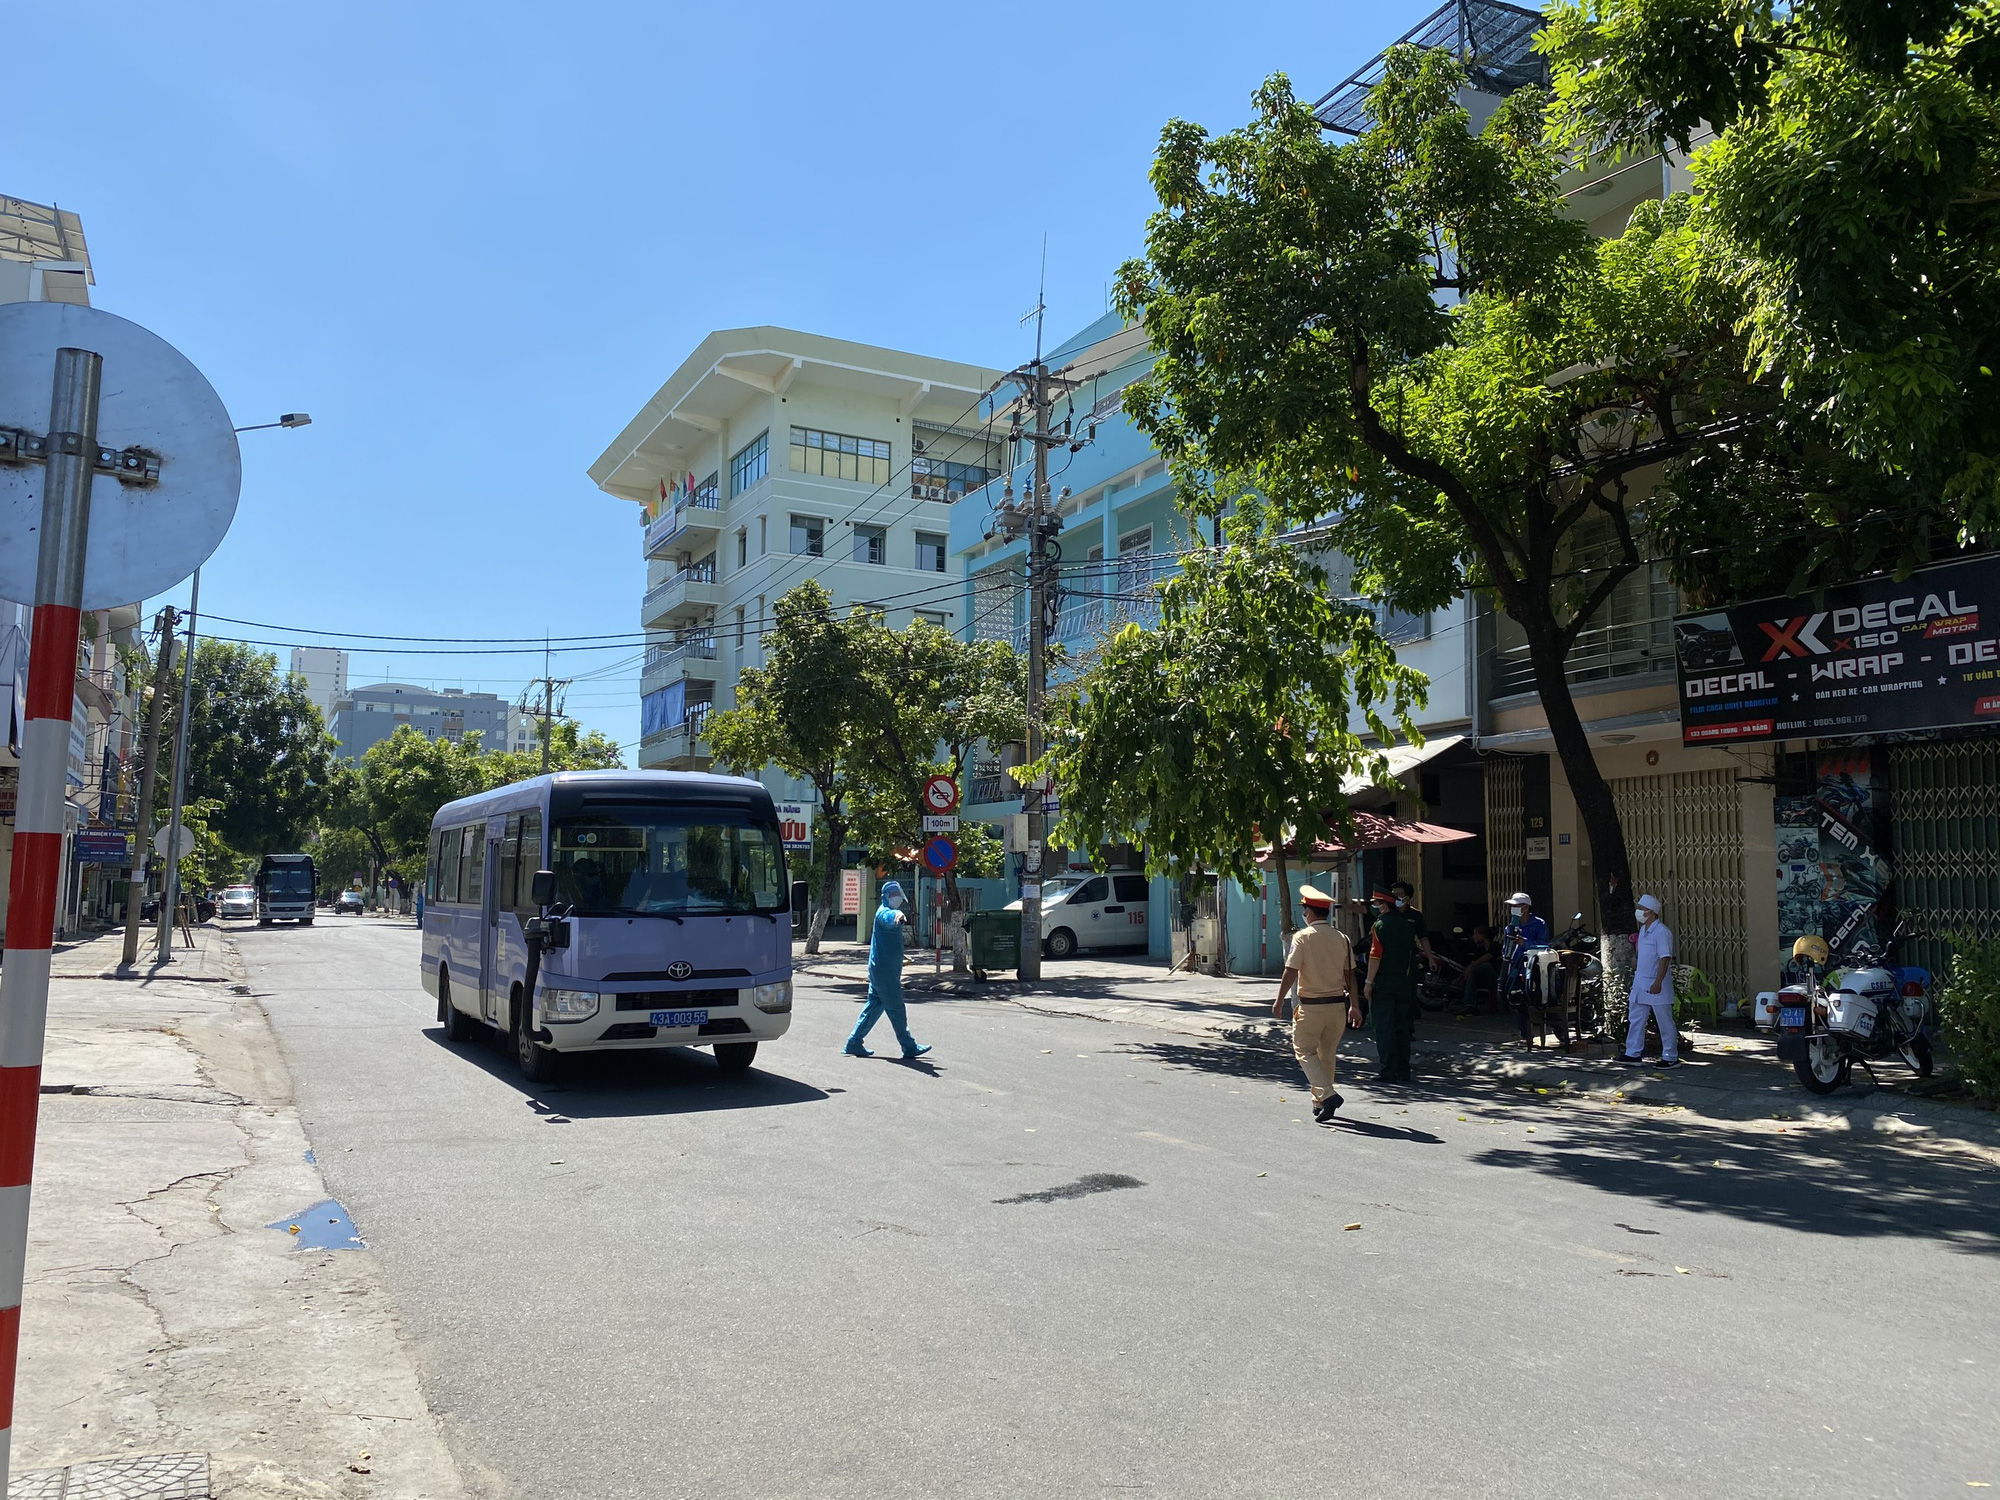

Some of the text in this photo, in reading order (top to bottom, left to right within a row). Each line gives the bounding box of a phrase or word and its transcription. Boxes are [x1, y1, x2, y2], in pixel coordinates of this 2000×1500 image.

[1832, 590, 1979, 634] DECAL
[1901, 616, 1967, 633] CAR WRAP
[1931, 623, 1978, 636] MOTOR
[1685, 671, 1775, 698] DECAL
[1810, 652, 1905, 682] WRAP
[1947, 639, 2000, 666] DE
[1880, 680, 1924, 692] WRAPPING
[1776, 720, 1807, 730] HOTLINE
[780, 817, 807, 841] ỨU
[931, 819, 951, 828] 100m
[1530, 816, 1544, 828] 129
[1818, 811, 1859, 851] TEM
[1127, 910, 1145, 925] 115
[1828, 902, 1873, 951] DECAL
[651, 1011, 707, 1025] 43A-003.55
